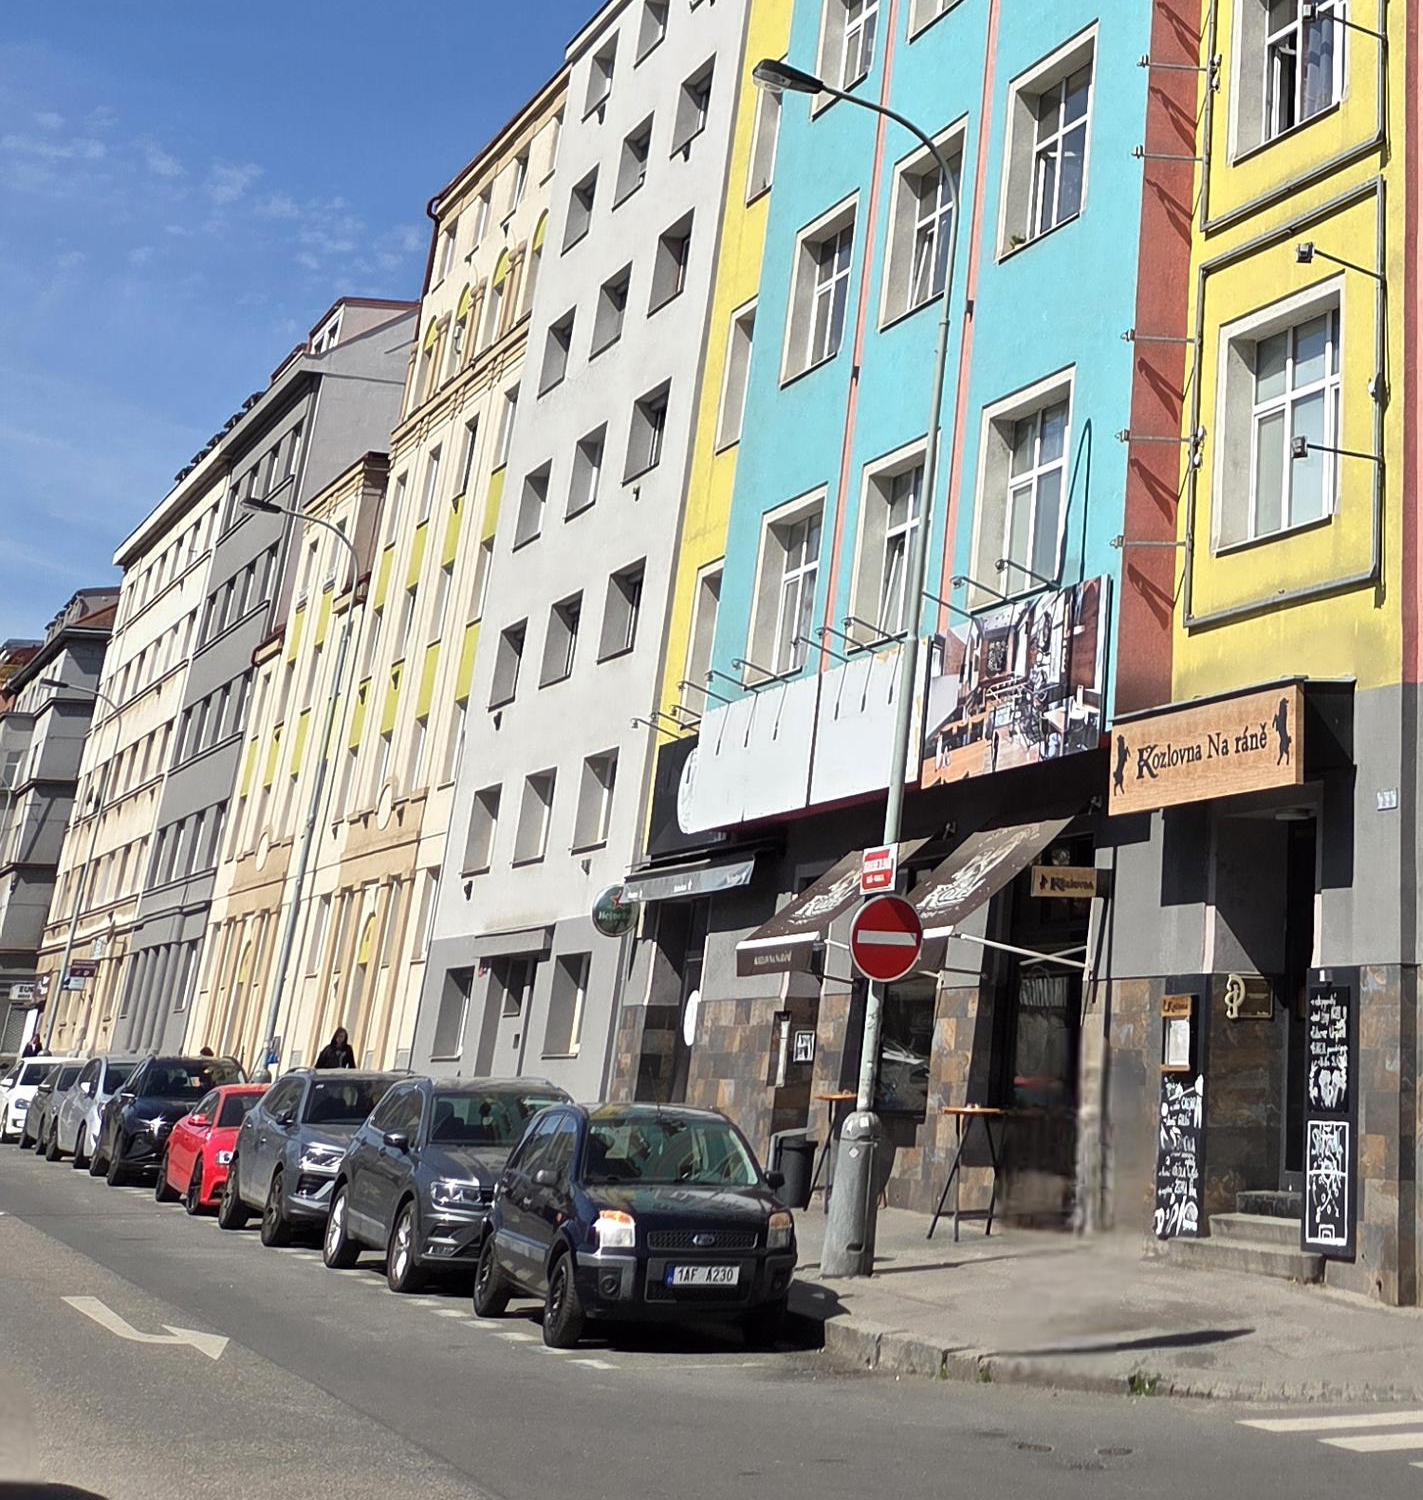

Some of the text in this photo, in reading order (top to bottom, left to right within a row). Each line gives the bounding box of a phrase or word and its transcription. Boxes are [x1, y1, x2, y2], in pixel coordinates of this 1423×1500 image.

[1136, 721, 1268, 780] Kozlovna Na ráně
[678, 1268, 734, 1282] 1AF A230
